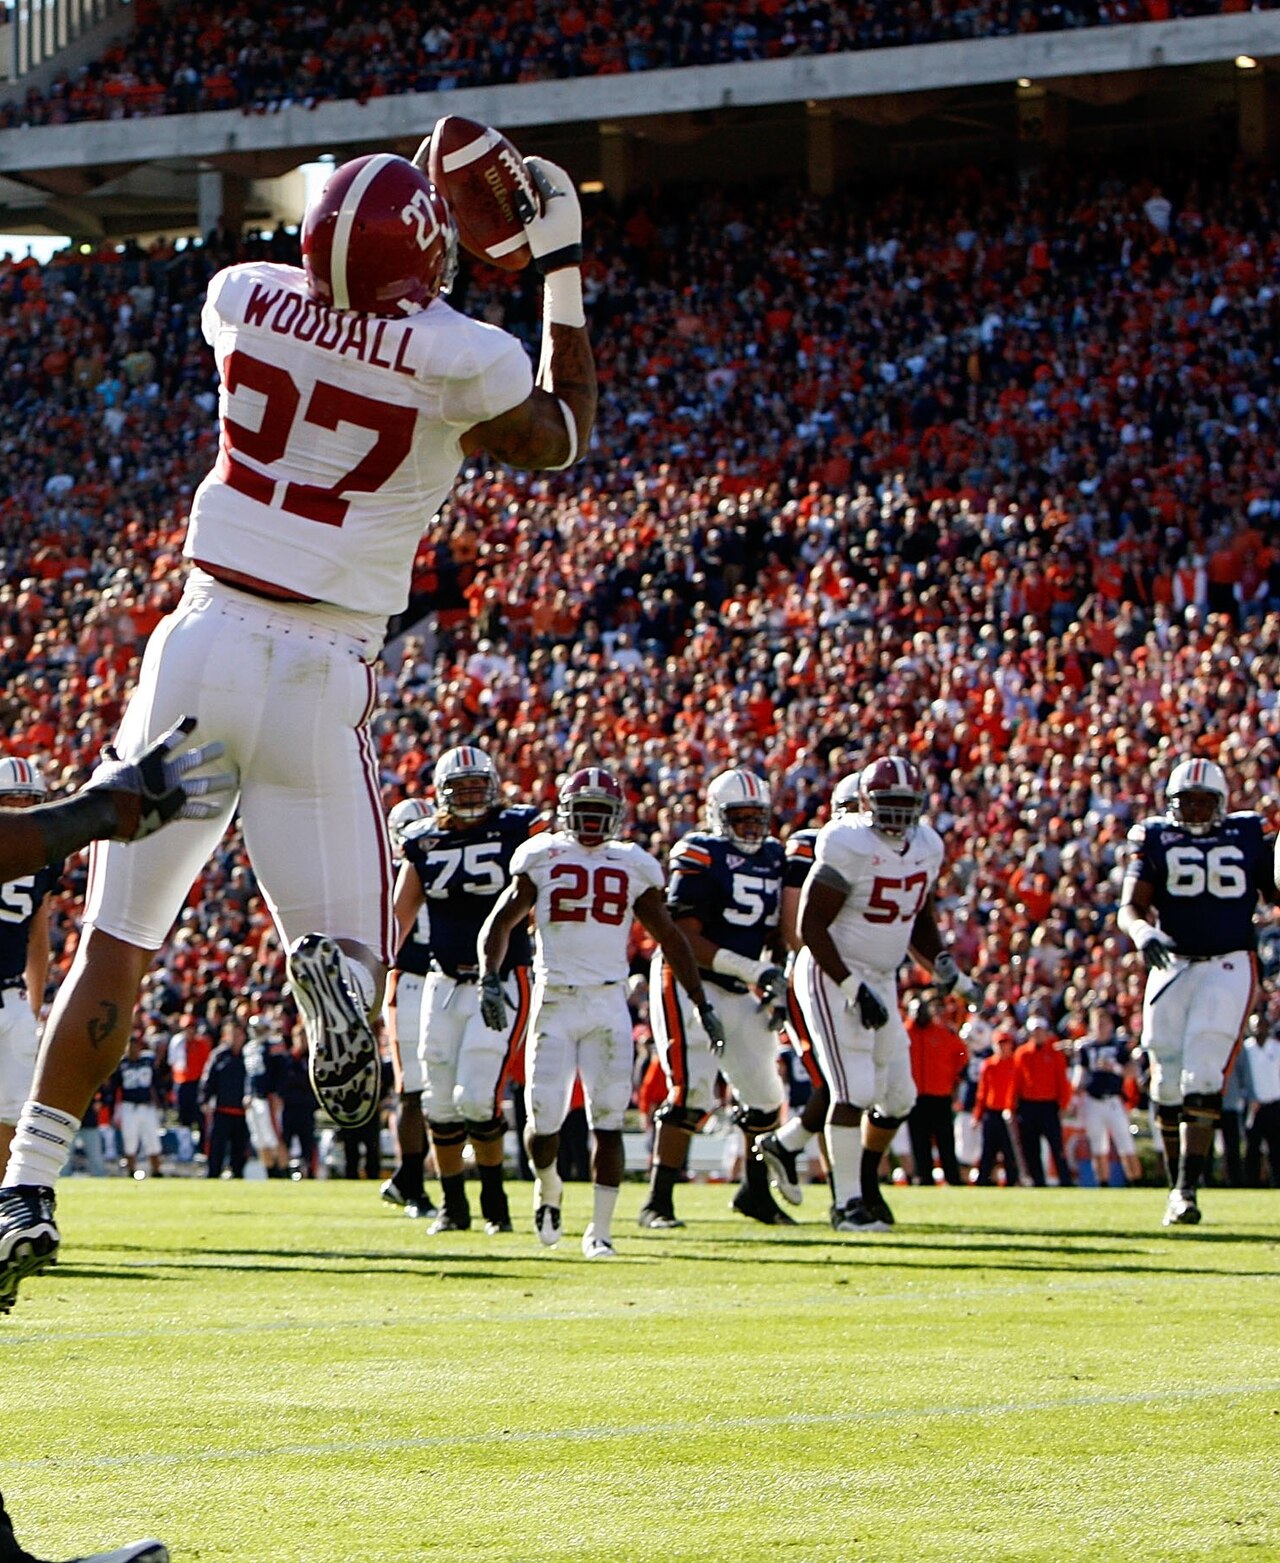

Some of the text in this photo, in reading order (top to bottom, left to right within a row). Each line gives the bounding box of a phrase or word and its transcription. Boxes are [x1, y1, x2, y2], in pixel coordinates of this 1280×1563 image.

[401, 189, 440, 251] 27
[243, 284, 417, 377] WOODALL
[220, 349, 418, 528] 27
[424, 842, 505, 899] 75
[550, 864, 629, 926] 28
[863, 872, 927, 924] 57
[1166, 845, 1247, 898] 66
